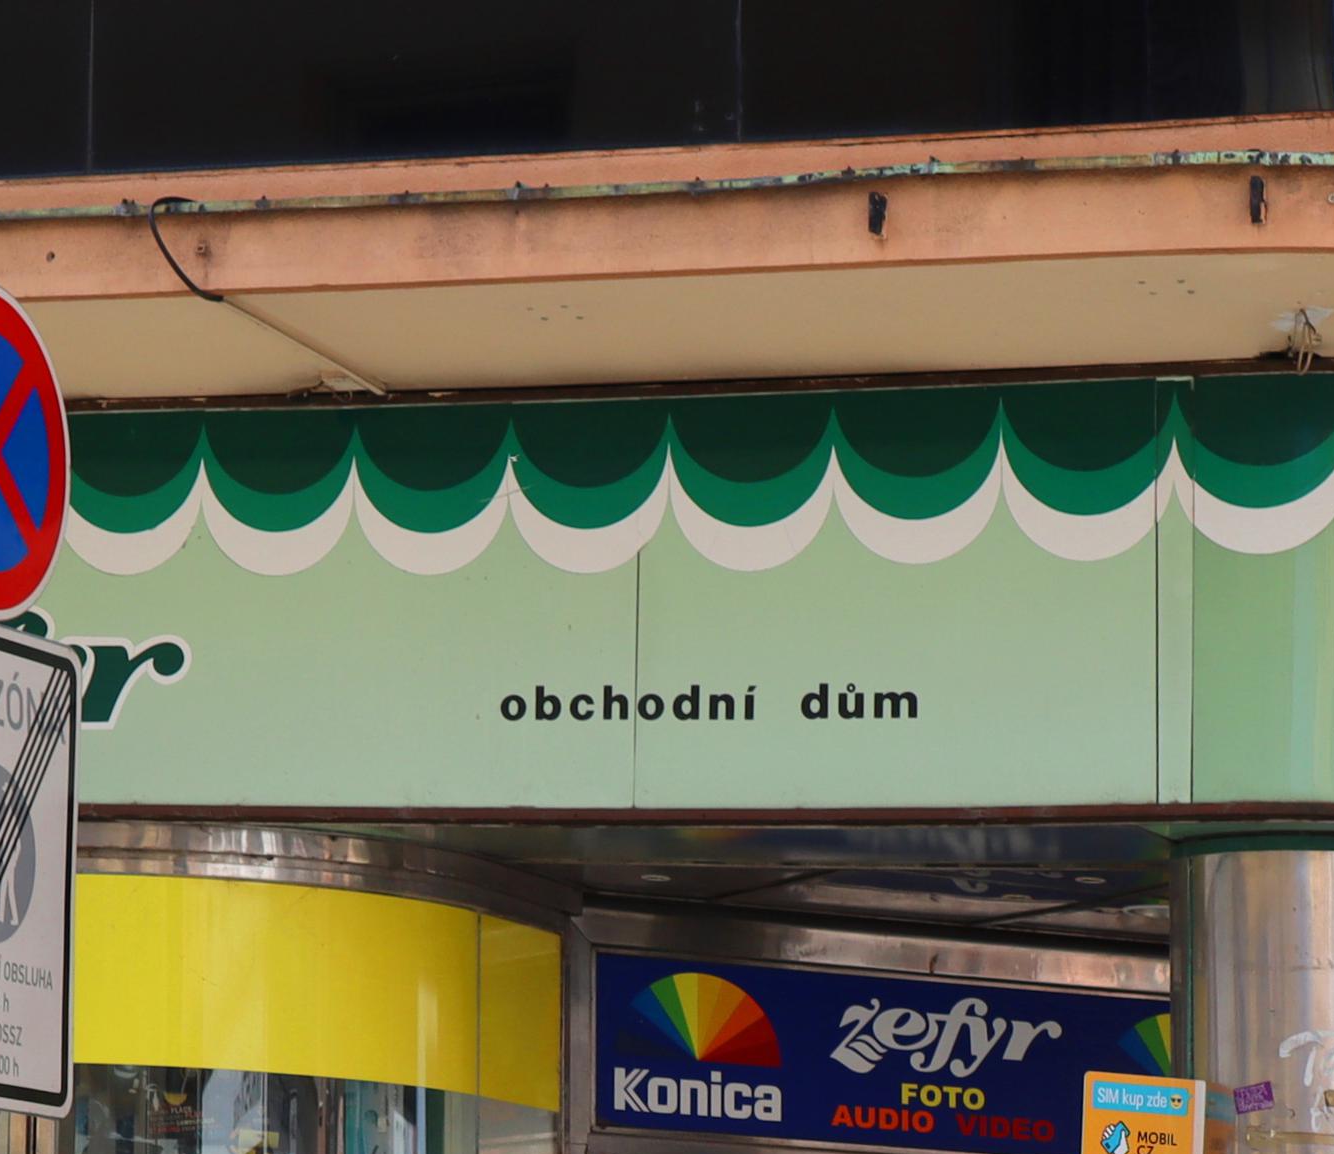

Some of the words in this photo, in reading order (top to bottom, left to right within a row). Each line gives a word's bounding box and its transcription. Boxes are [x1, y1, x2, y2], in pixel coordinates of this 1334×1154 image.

[501, 685, 756, 721] obchodní
[801, 683, 918, 719] dům
[3, 961, 53, 991] OBSLUHA
[3, 994, 10, 1013] h
[12, 1058, 20, 1077] h
[613, 1066, 783, 1123] Konica
[900, 1082, 986, 1111] FOTO
[1097, 1087, 1119, 1106] SIM
[1122, 1089, 1144, 1109] kup
[1146, 1091, 1168, 1108] zde
[830, 1104, 935, 1134] AUDIO
[955, 1113, 1055, 1143] VIDEO
[1137, 1131, 1178, 1147] MOBIL
